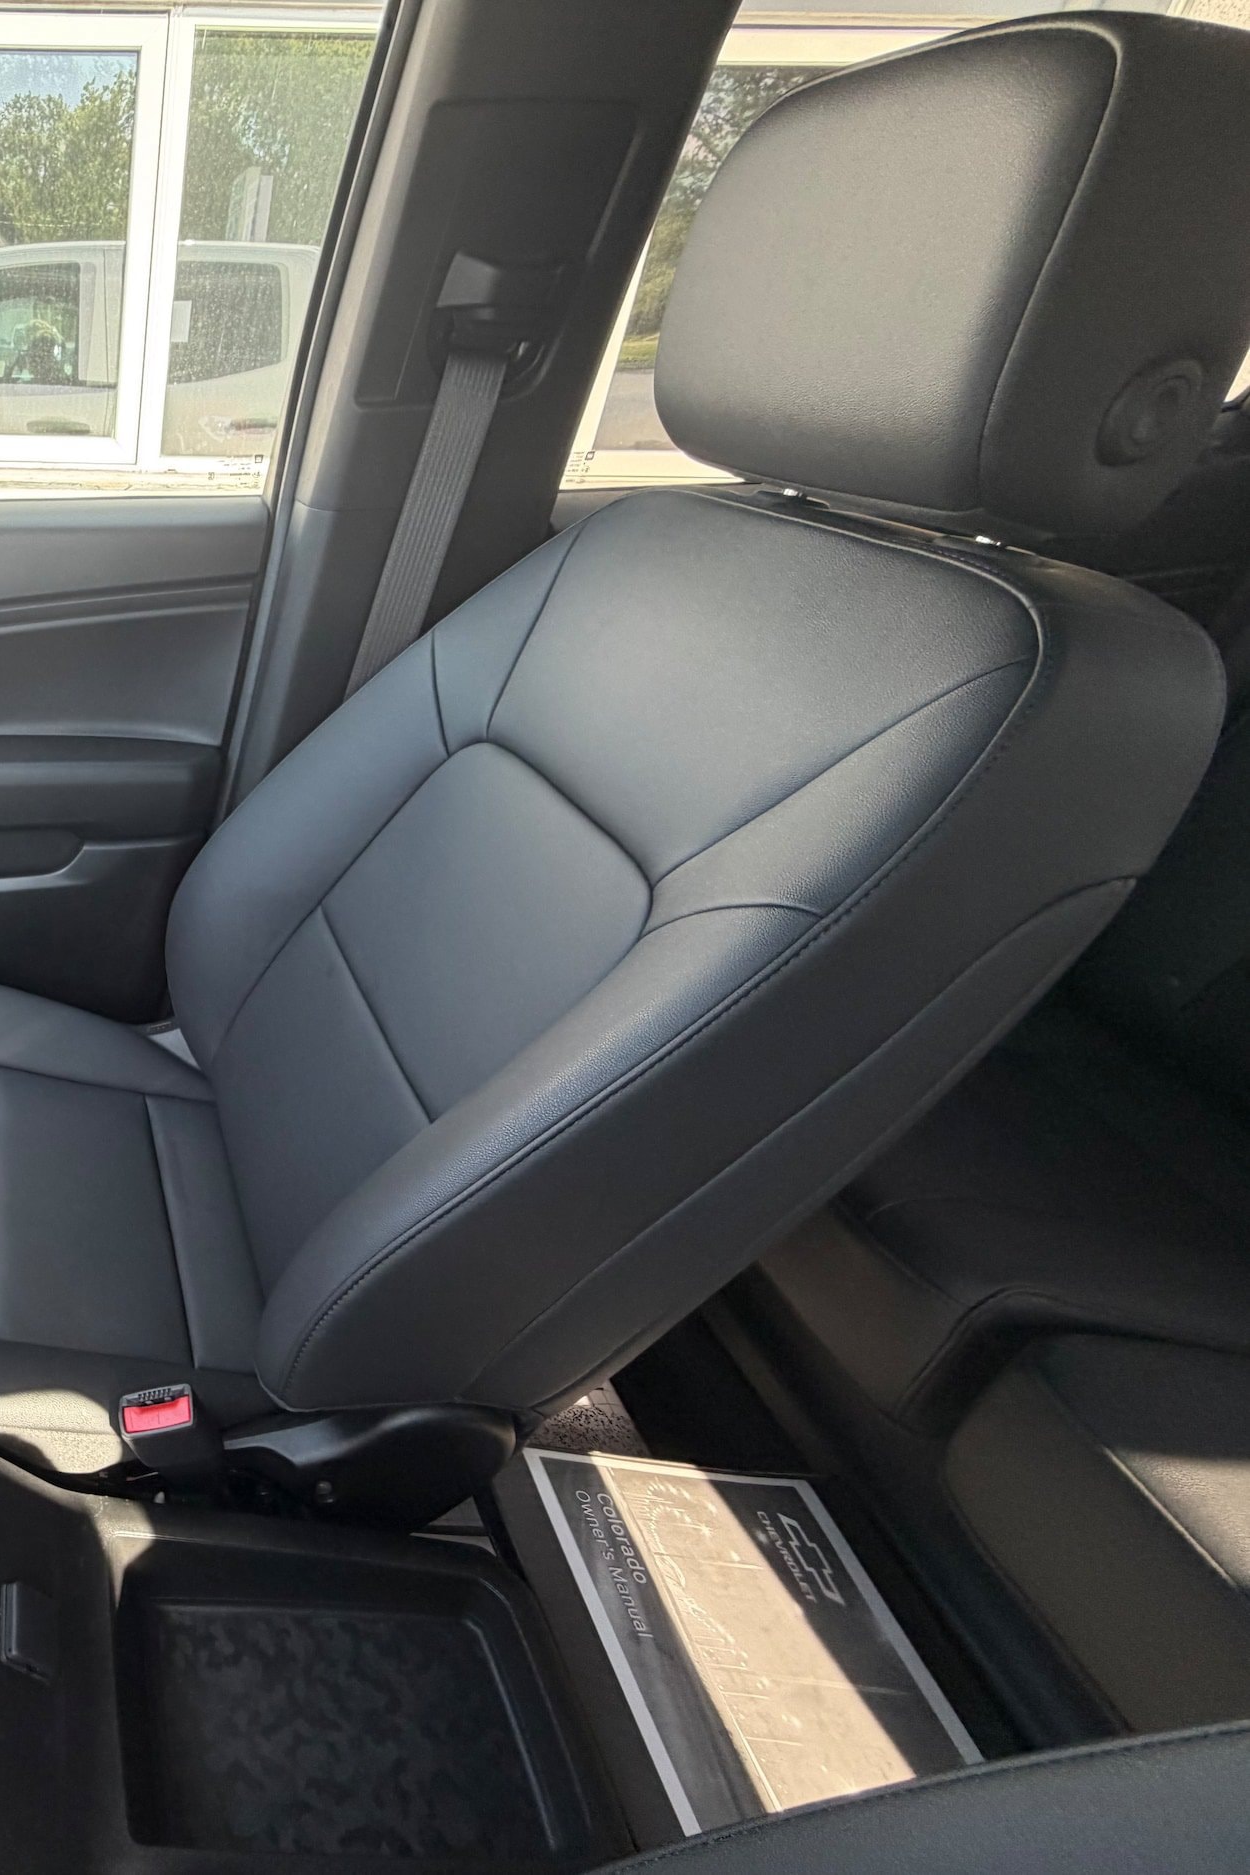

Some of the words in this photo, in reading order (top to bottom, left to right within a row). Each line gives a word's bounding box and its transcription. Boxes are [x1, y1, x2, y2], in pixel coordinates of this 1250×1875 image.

[575, 1490, 615, 1561] Owner's
[609, 1566, 654, 1638] Manual
[597, 1493, 647, 1584] Colorado
[756, 1511, 818, 1604] CHEVROLET
